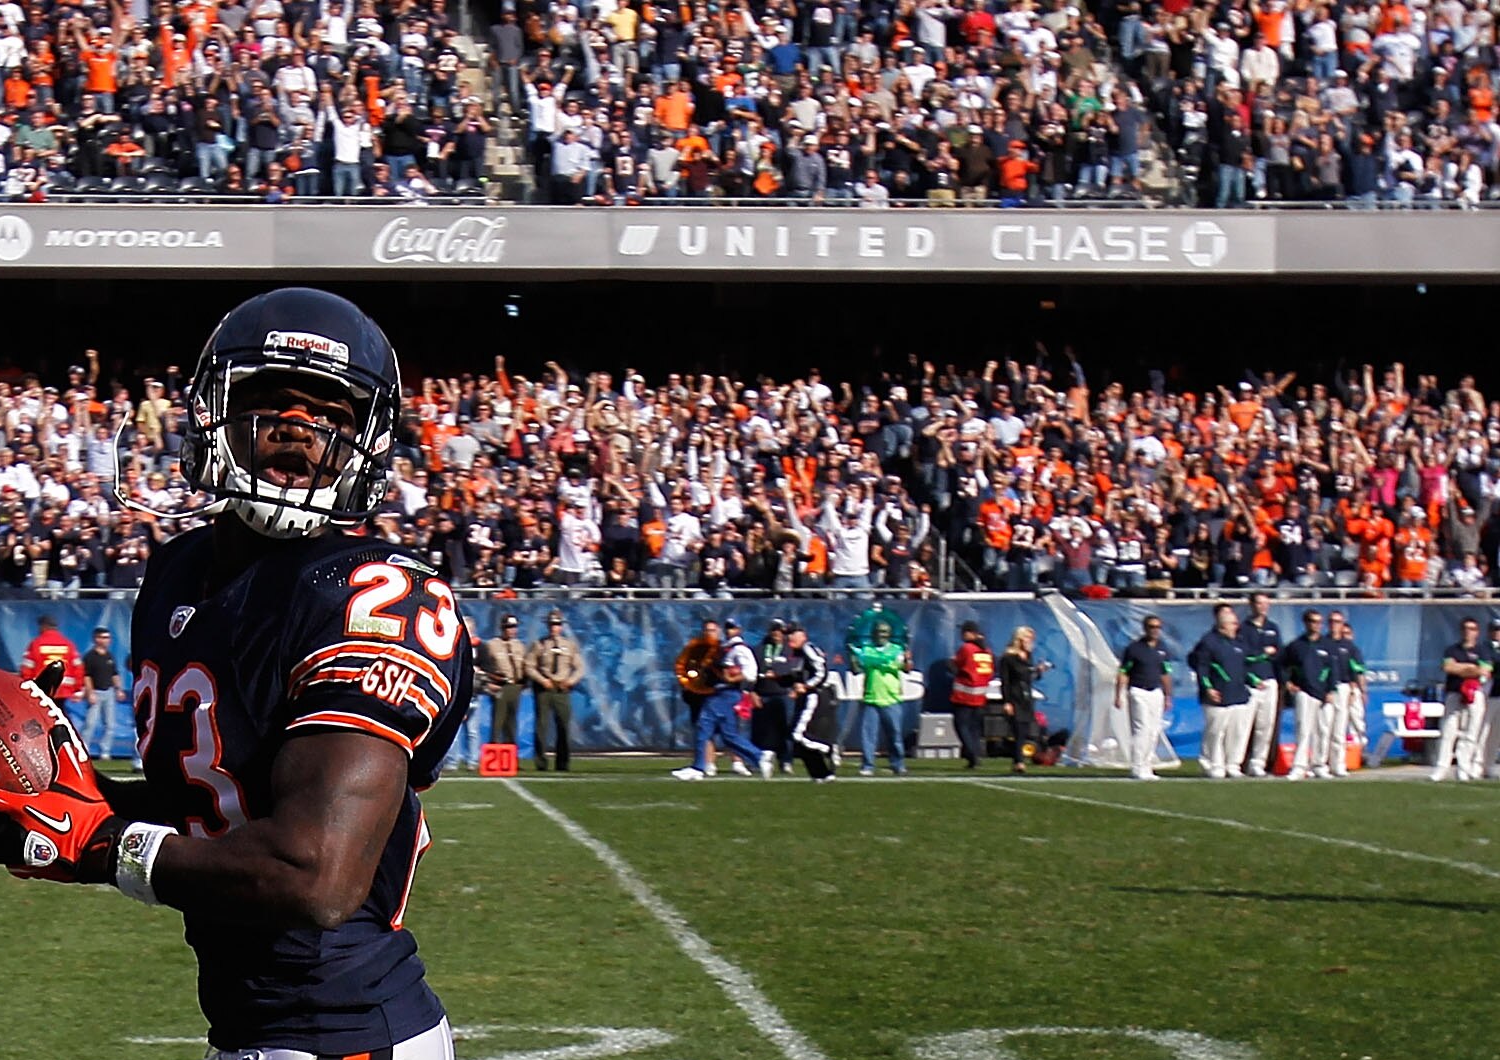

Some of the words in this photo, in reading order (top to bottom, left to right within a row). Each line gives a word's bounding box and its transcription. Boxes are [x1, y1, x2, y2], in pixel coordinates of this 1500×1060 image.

[44, 229, 225, 248] MOTOROLA
[678, 225, 936, 257] UNITED
[991, 225, 1171, 261] CHASE
[286, 336, 330, 352] Riddell
[1280, 524, 1303, 545] 54
[344, 562, 463, 661] 23
[361, 660, 416, 706] GSH
[485, 749, 512, 773] 20
